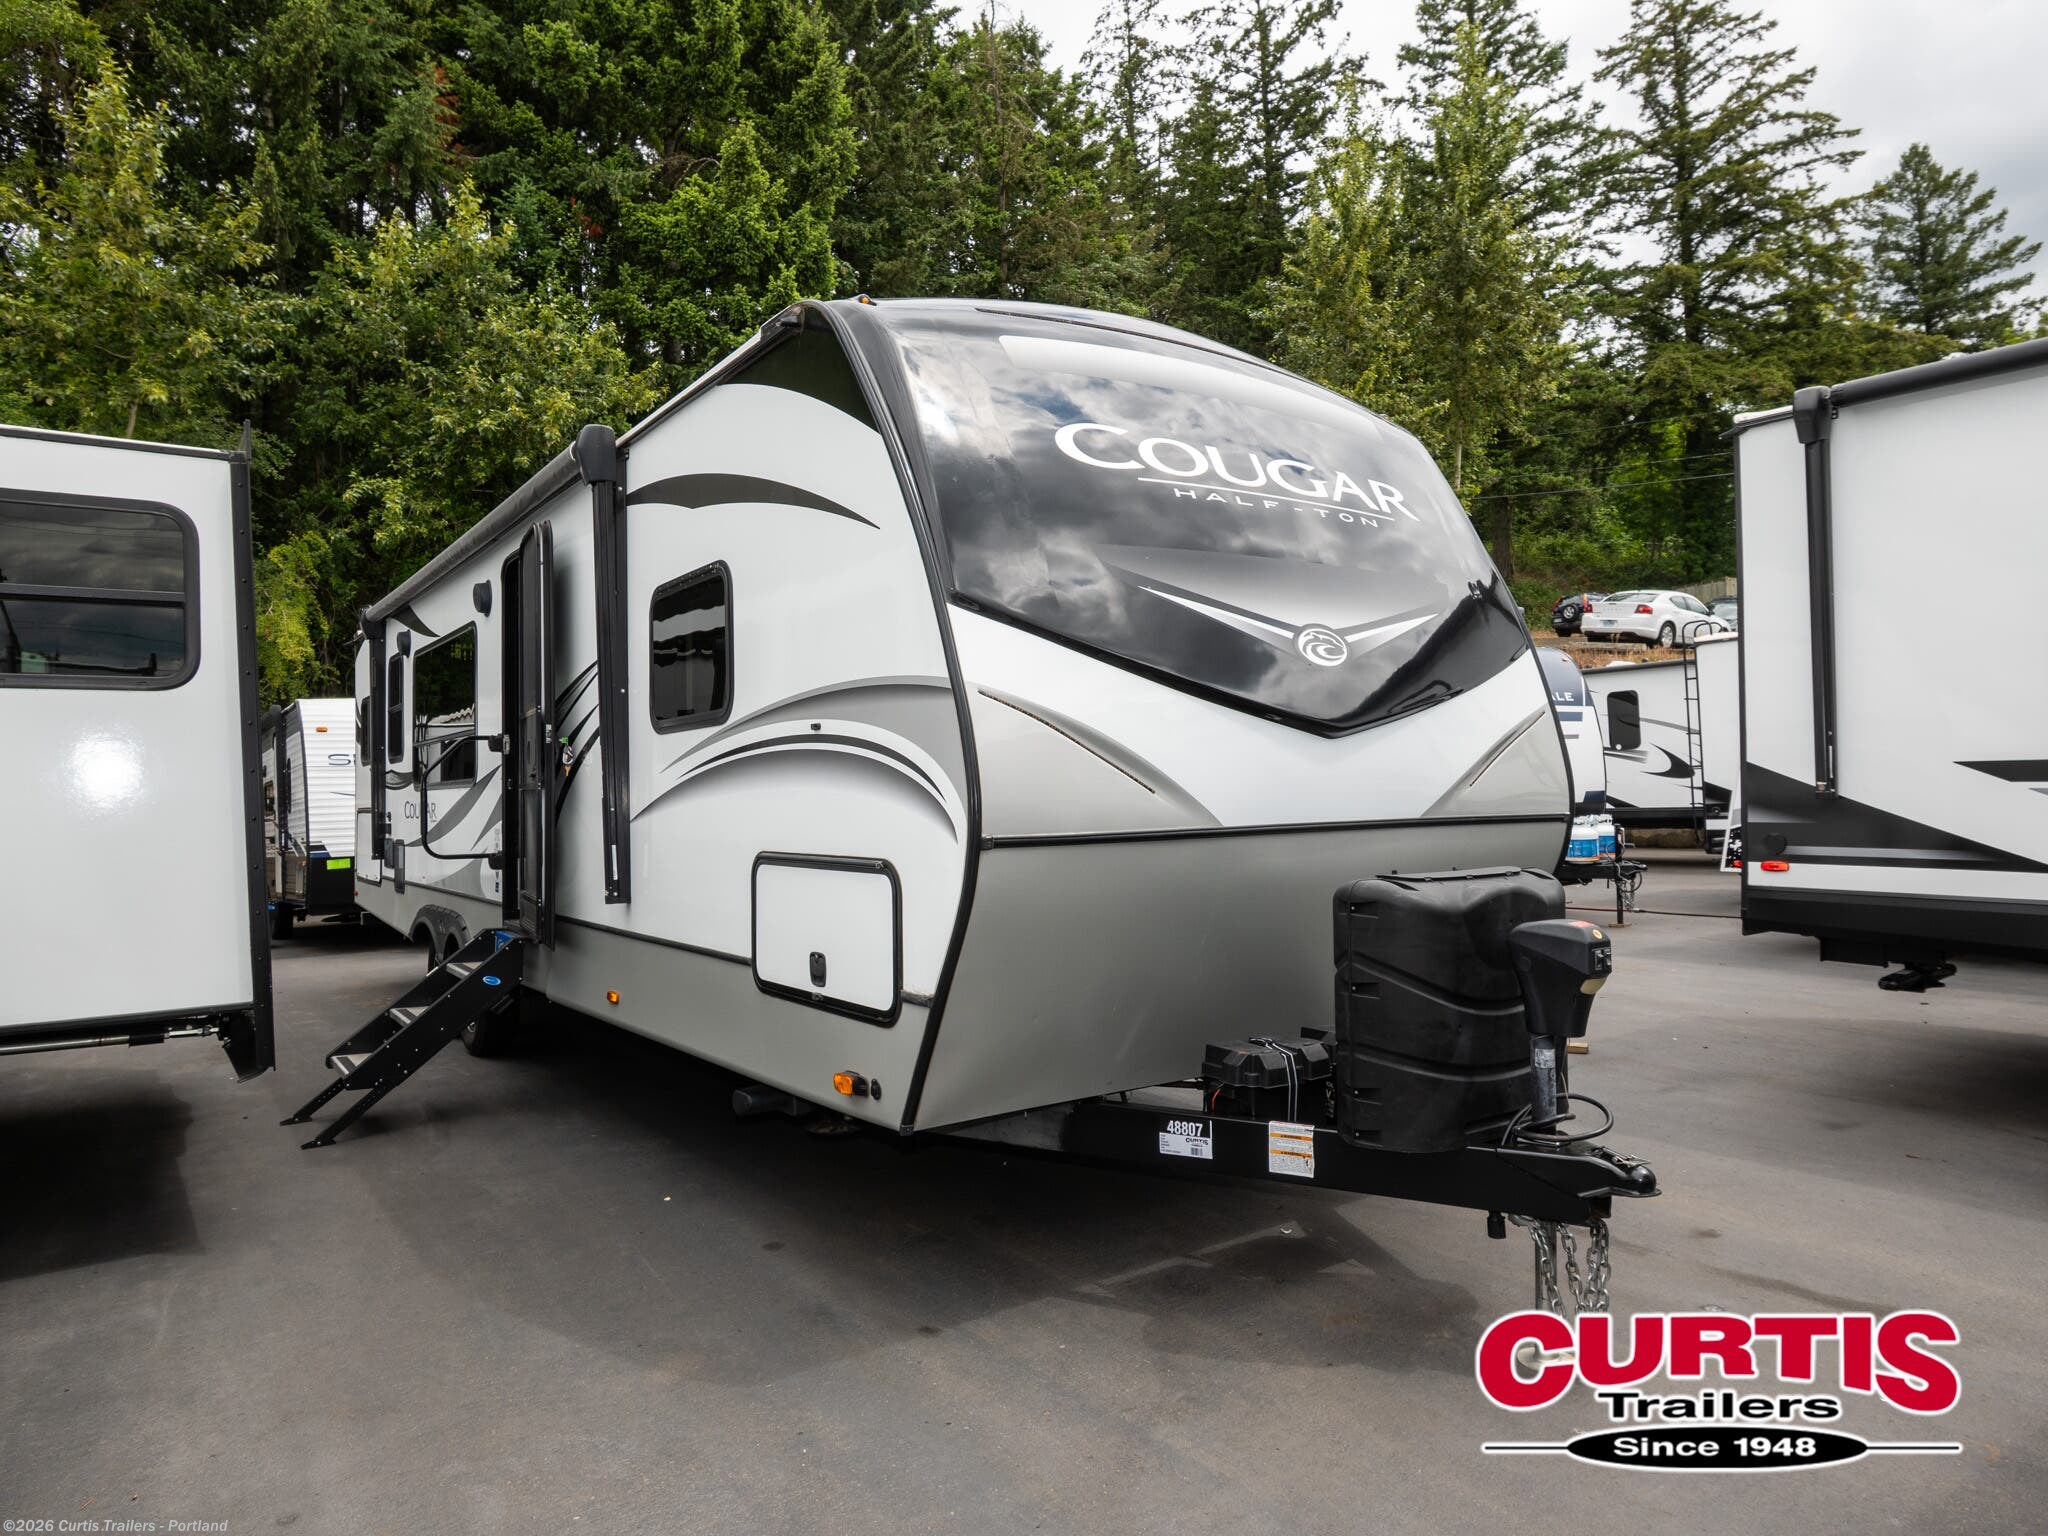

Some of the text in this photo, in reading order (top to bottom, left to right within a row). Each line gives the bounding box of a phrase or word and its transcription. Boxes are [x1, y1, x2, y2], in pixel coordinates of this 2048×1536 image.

[1055, 422, 1420, 521] COUGAR
[404, 800, 437, 819] COUAR
[1167, 1119, 1203, 1137] 48807
